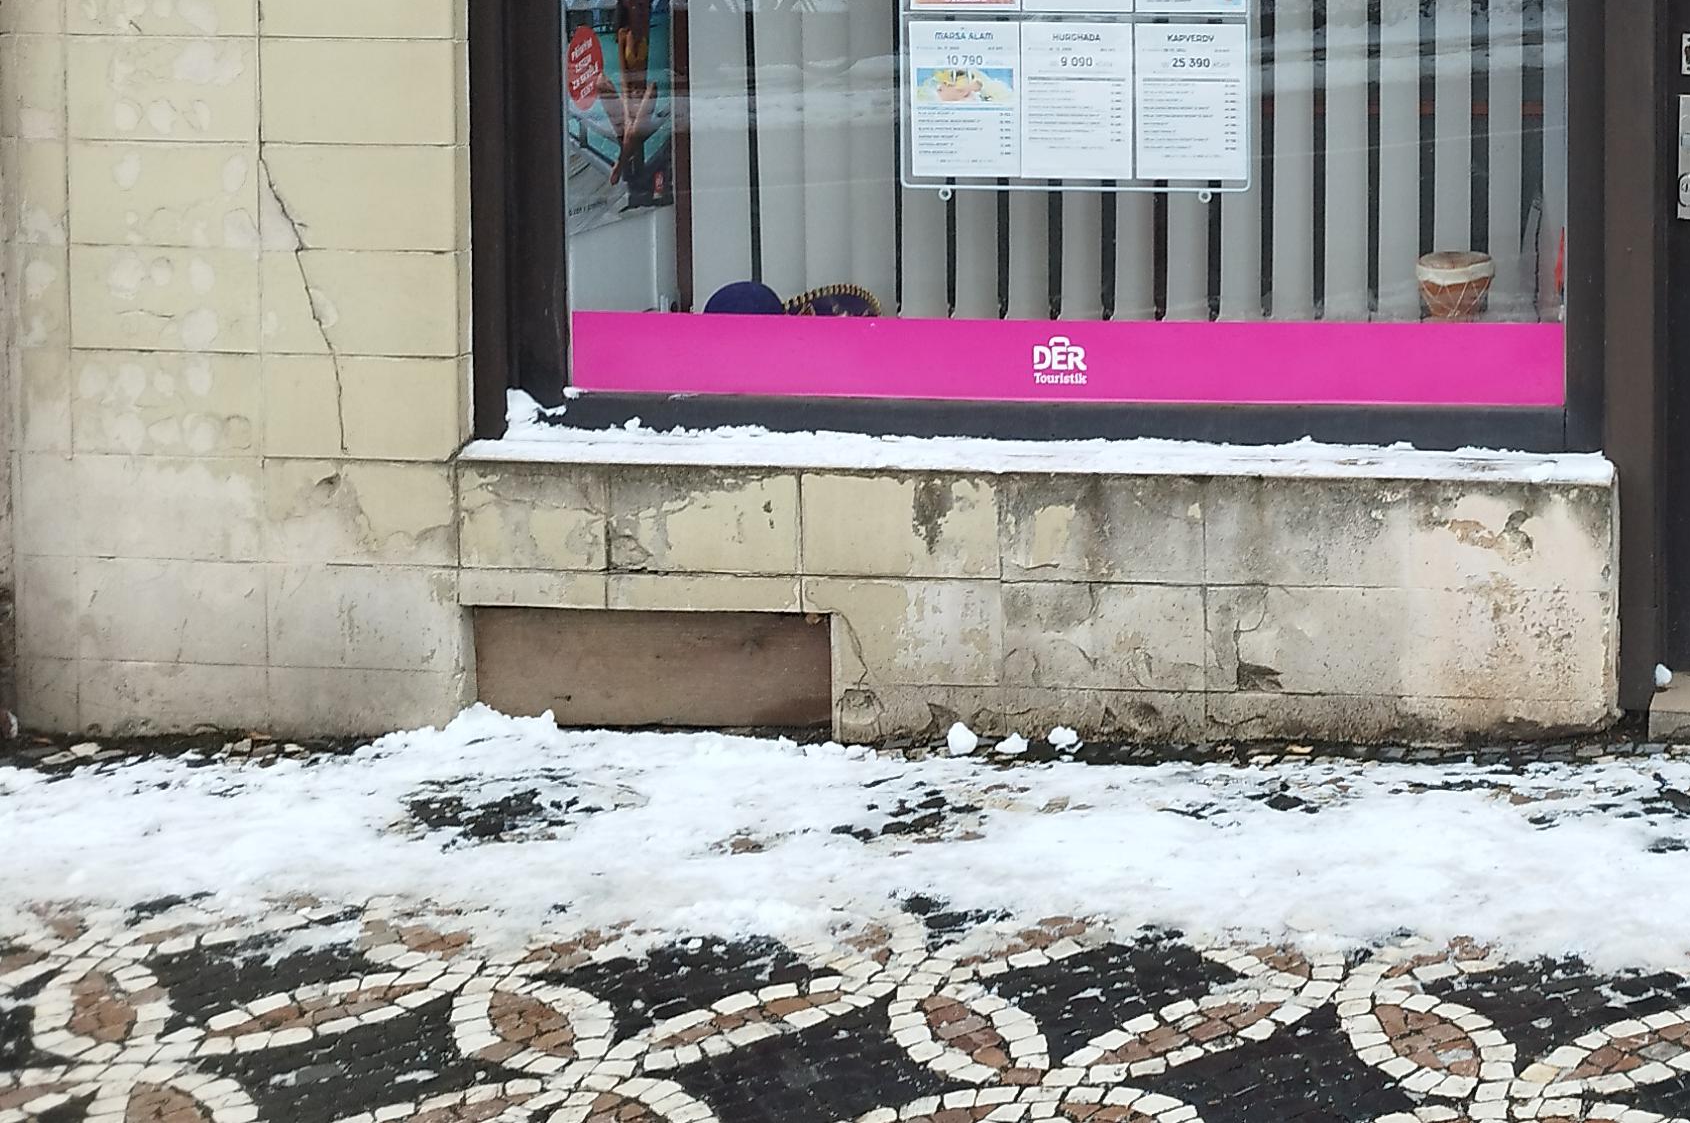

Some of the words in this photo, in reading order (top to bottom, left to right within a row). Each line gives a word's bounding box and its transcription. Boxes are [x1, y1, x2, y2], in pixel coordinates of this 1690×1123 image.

[947, 55, 959, 65] 10
[1172, 57, 1186, 68] 25
[1033, 344, 1087, 371] DER
[1033, 372, 1087, 385] Touristik
